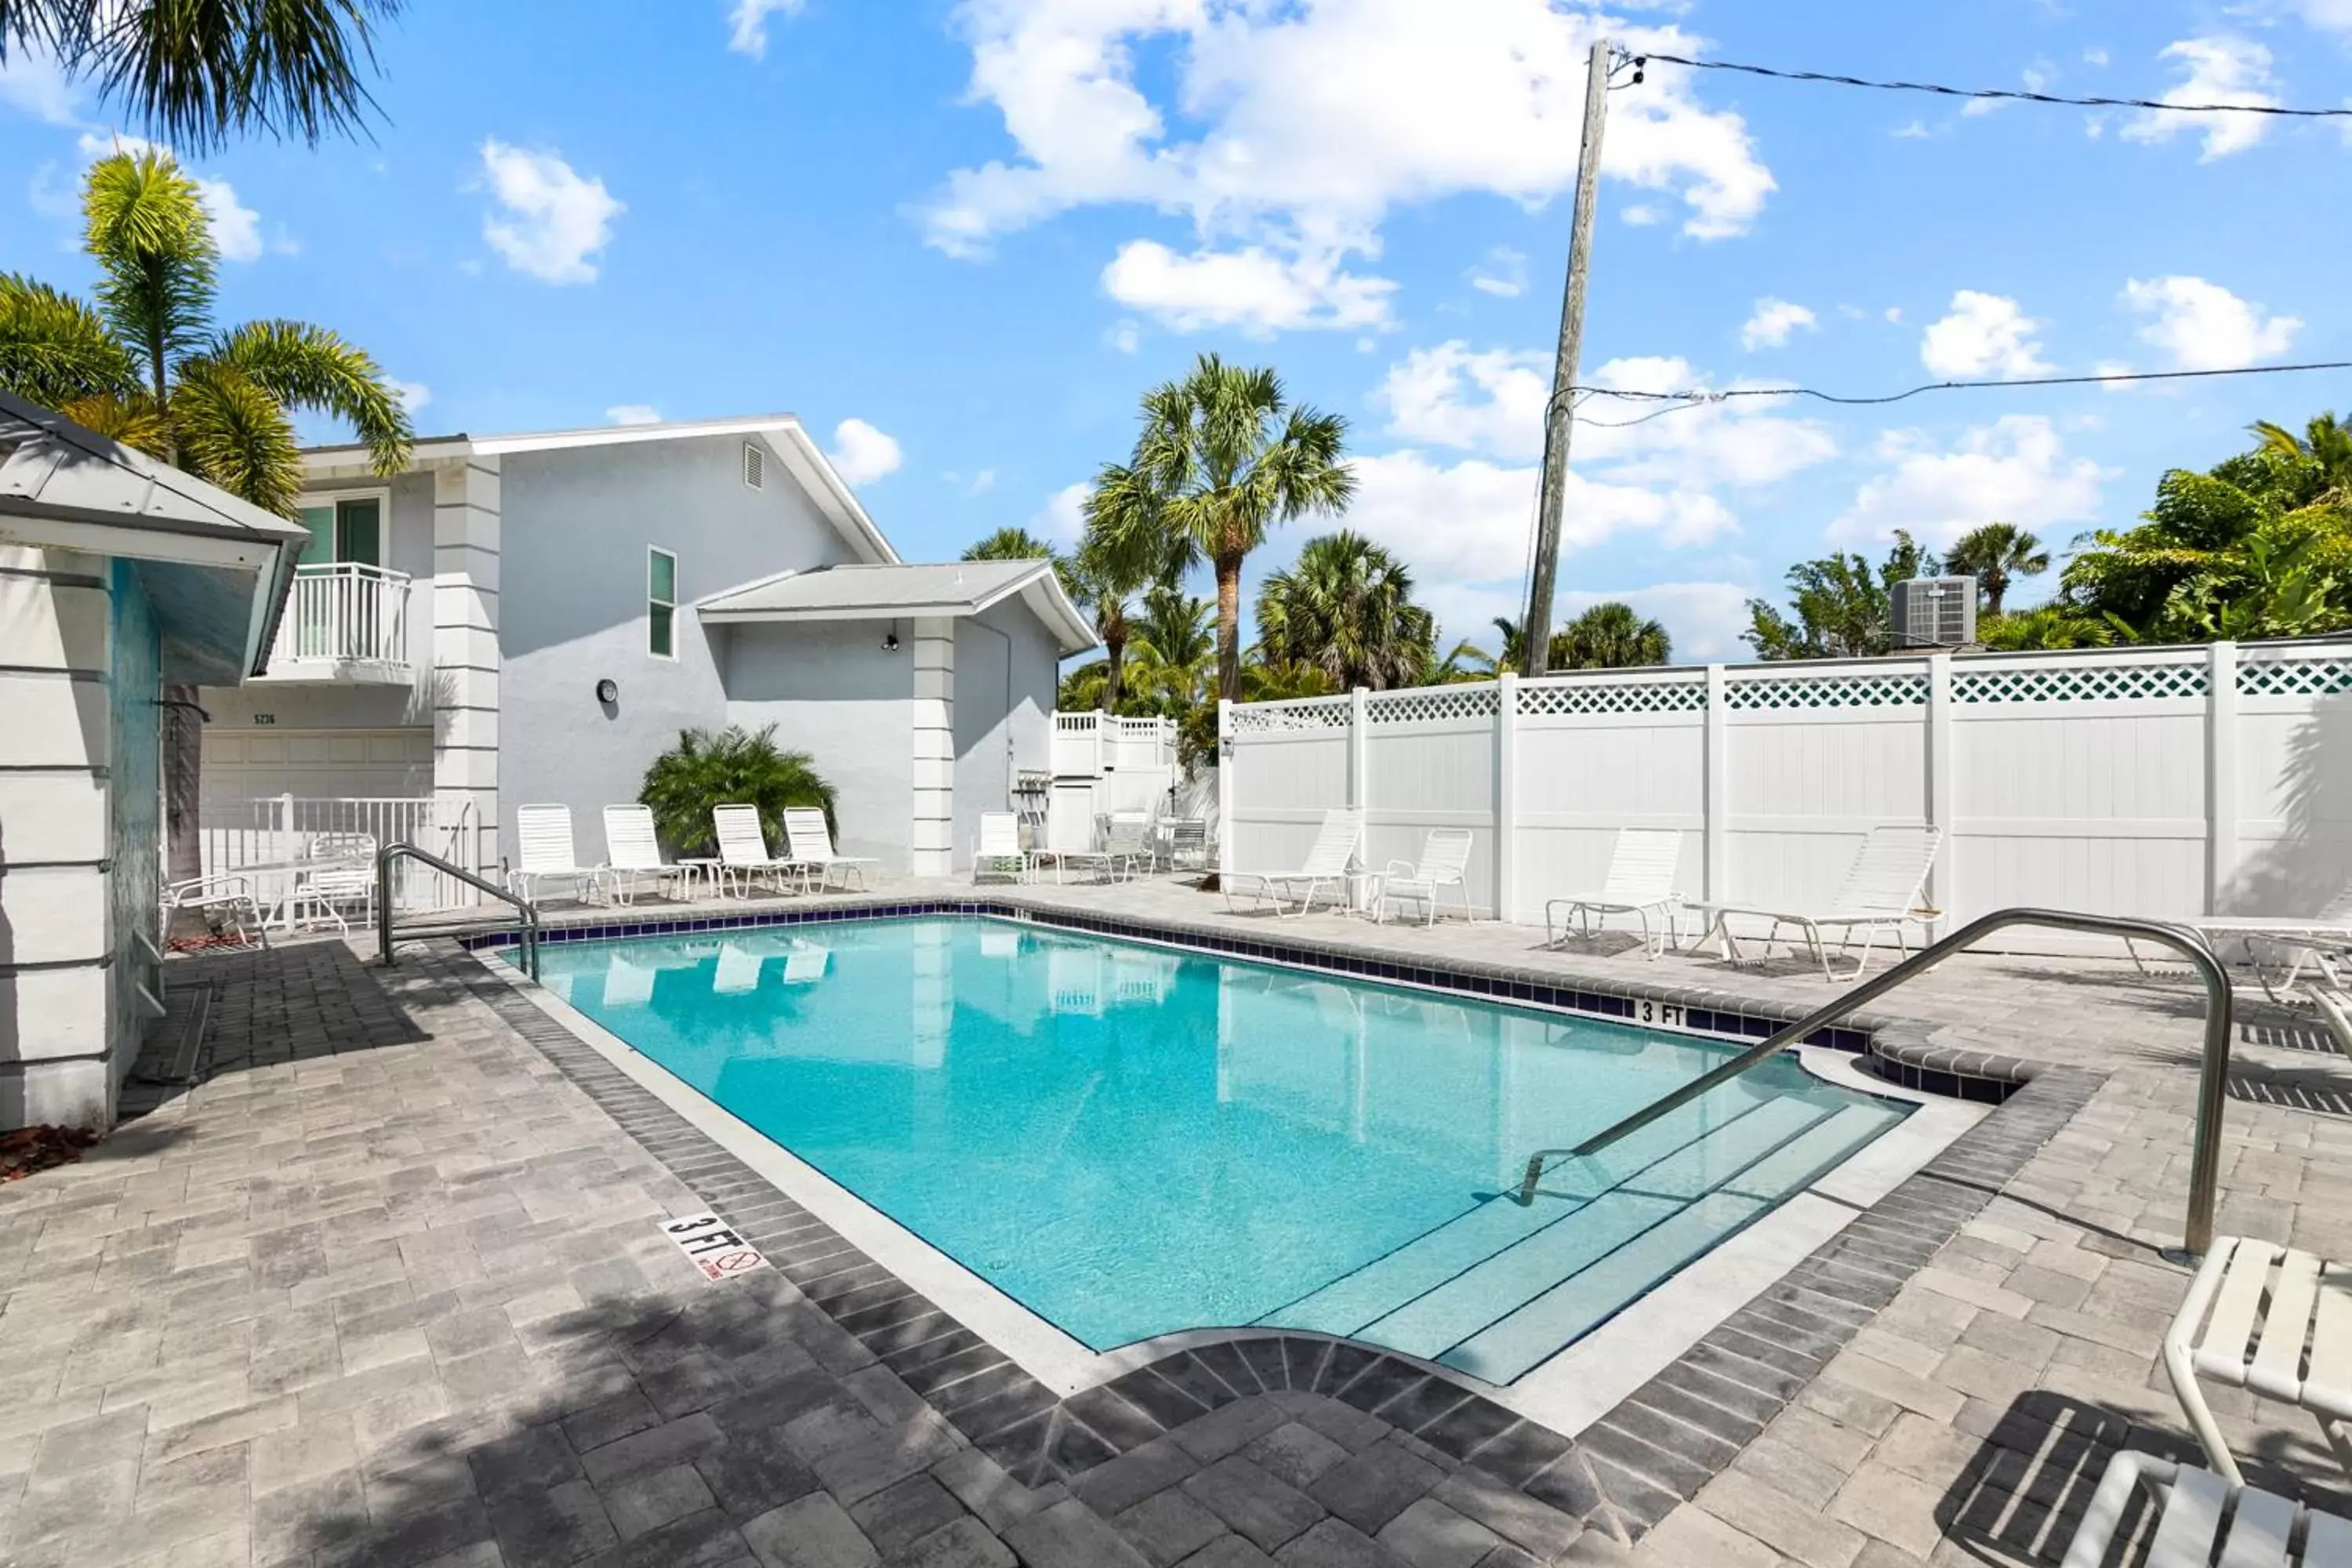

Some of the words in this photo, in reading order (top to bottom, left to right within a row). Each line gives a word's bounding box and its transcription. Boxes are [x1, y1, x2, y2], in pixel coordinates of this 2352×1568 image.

[1642, 1001, 1653, 1022] 3
[1662, 1004, 1684, 1026] FT
[668, 1218, 717, 1232] 3
[680, 1229, 744, 1254] FT
